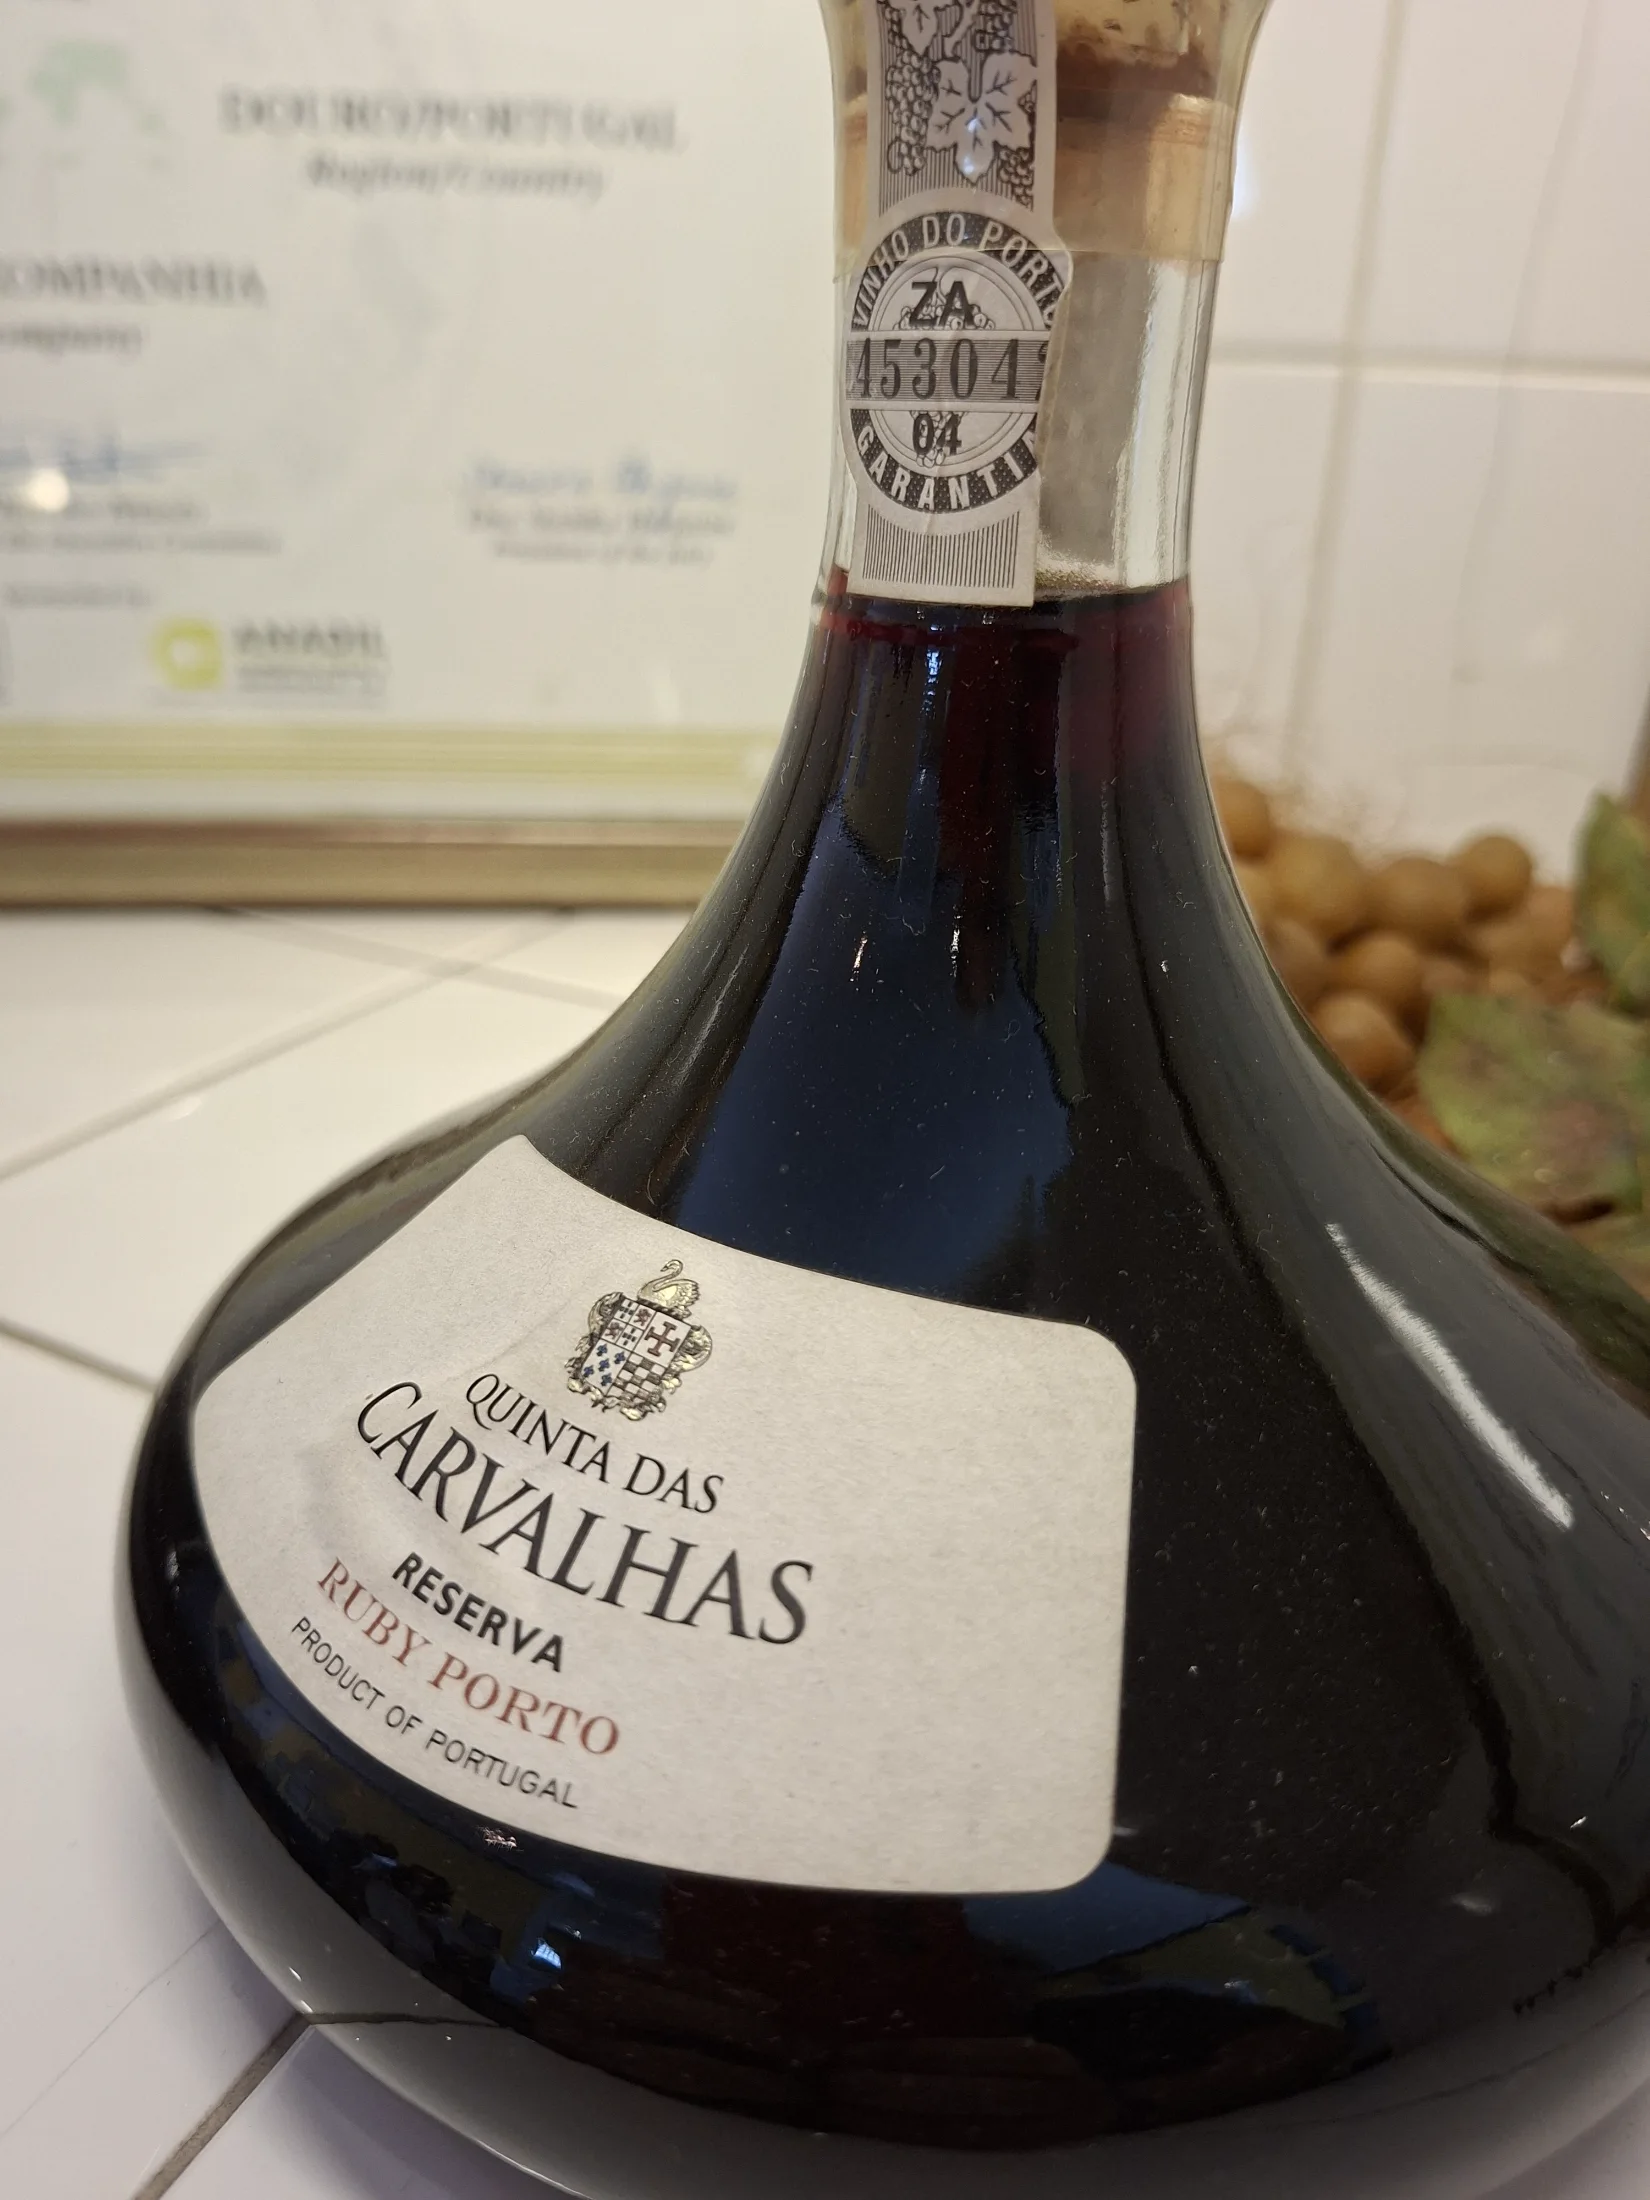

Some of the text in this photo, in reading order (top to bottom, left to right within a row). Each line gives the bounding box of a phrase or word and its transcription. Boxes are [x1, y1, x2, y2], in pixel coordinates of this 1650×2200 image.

[854, 231, 909, 328] VINHO
[921, 212, 967, 249] DO
[909, 280, 974, 328] ZA
[856, 337, 1047, 400] 45304
[912, 413, 962, 456] 04
[466, 1373, 724, 1514] QUINTA DAS
[357, 1381, 815, 1645] CARVALHAS
[317, 1556, 621, 1756] RUBY PORTO
[392, 1552, 566, 1673] RESERVA
[292, 1616, 579, 1809] PRODUCT OF PORTUGAL
